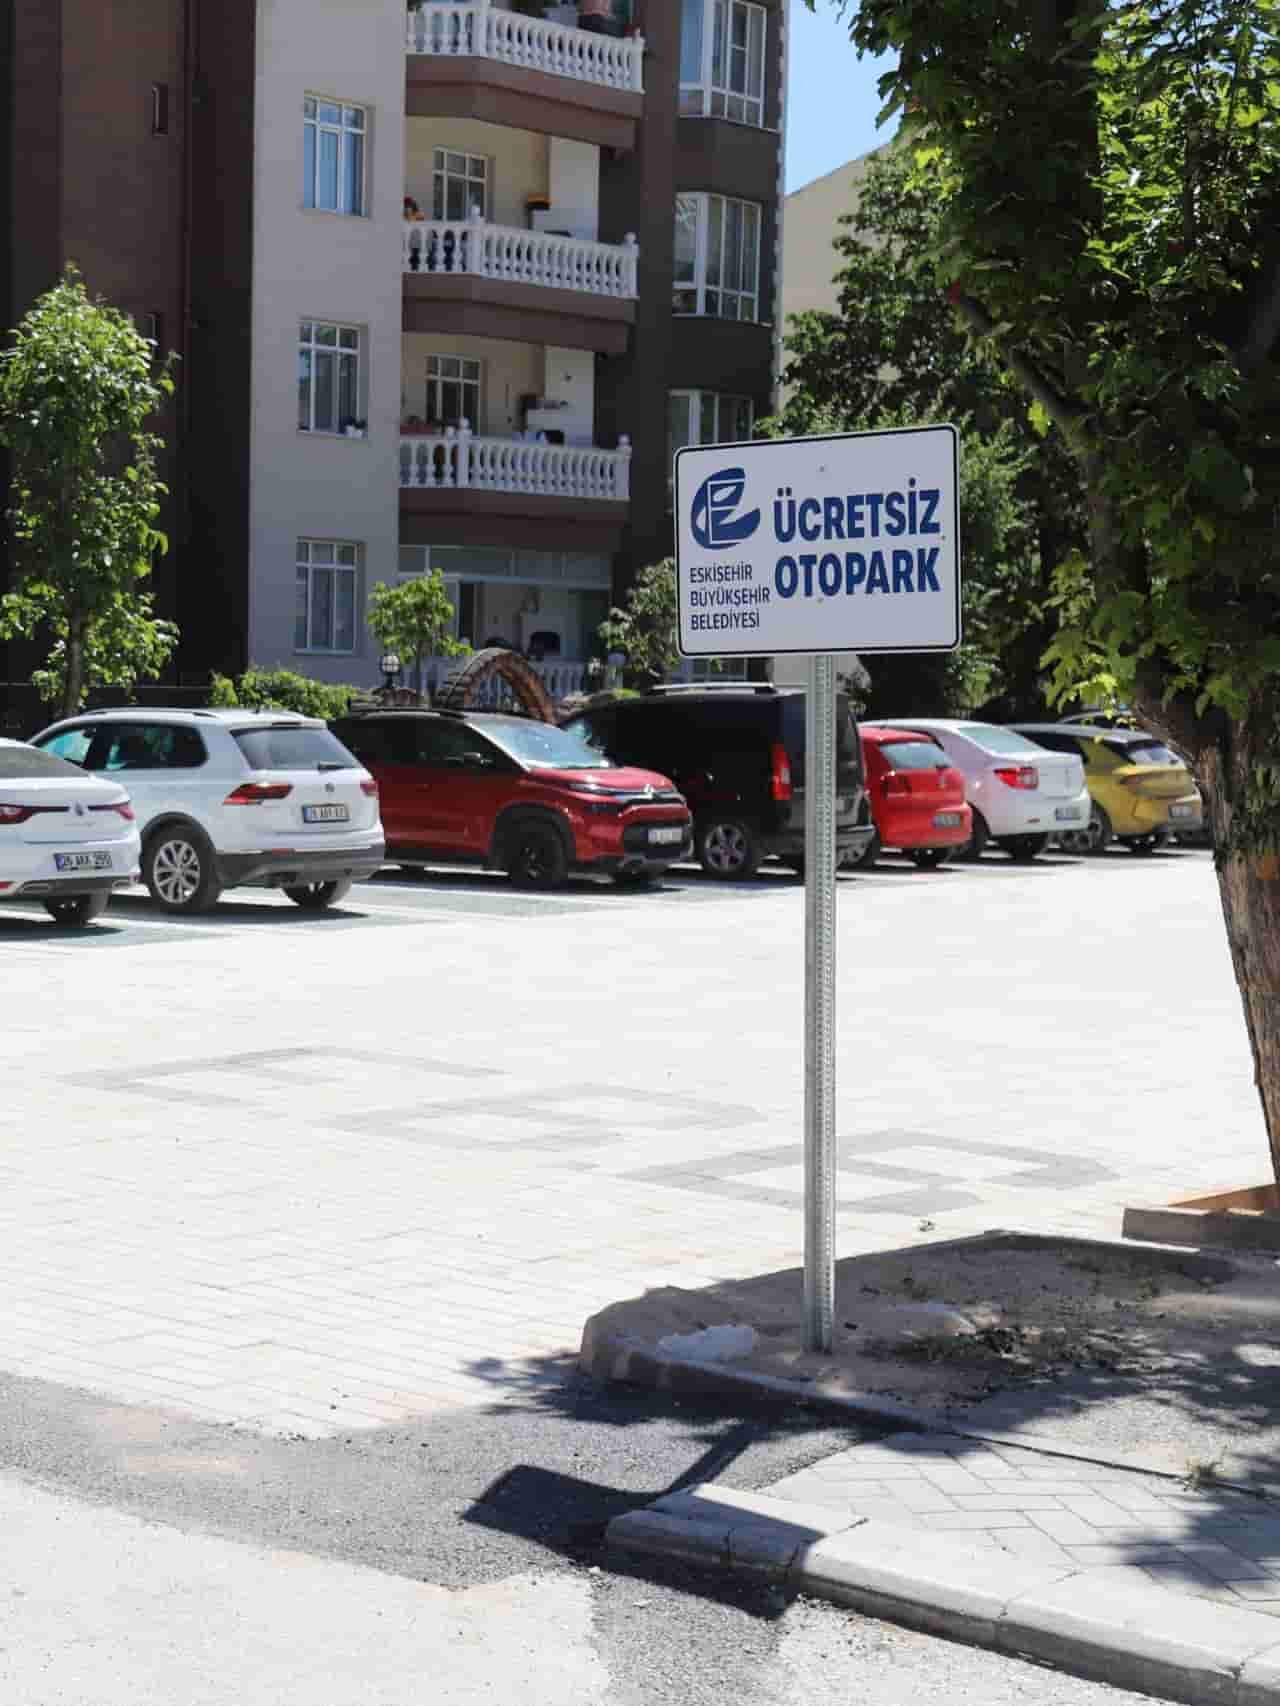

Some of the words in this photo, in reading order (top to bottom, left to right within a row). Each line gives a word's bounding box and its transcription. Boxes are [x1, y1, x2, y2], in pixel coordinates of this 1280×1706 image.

[774, 477, 940, 543] ÜCRETSİZ
[690, 560, 752, 584] ESKİŞEHİR
[775, 547, 940, 599] OTOPARK
[690, 588, 770, 608] BÜYÜKŞEHİR
[691, 608, 760, 630] BELEDİYESİ
